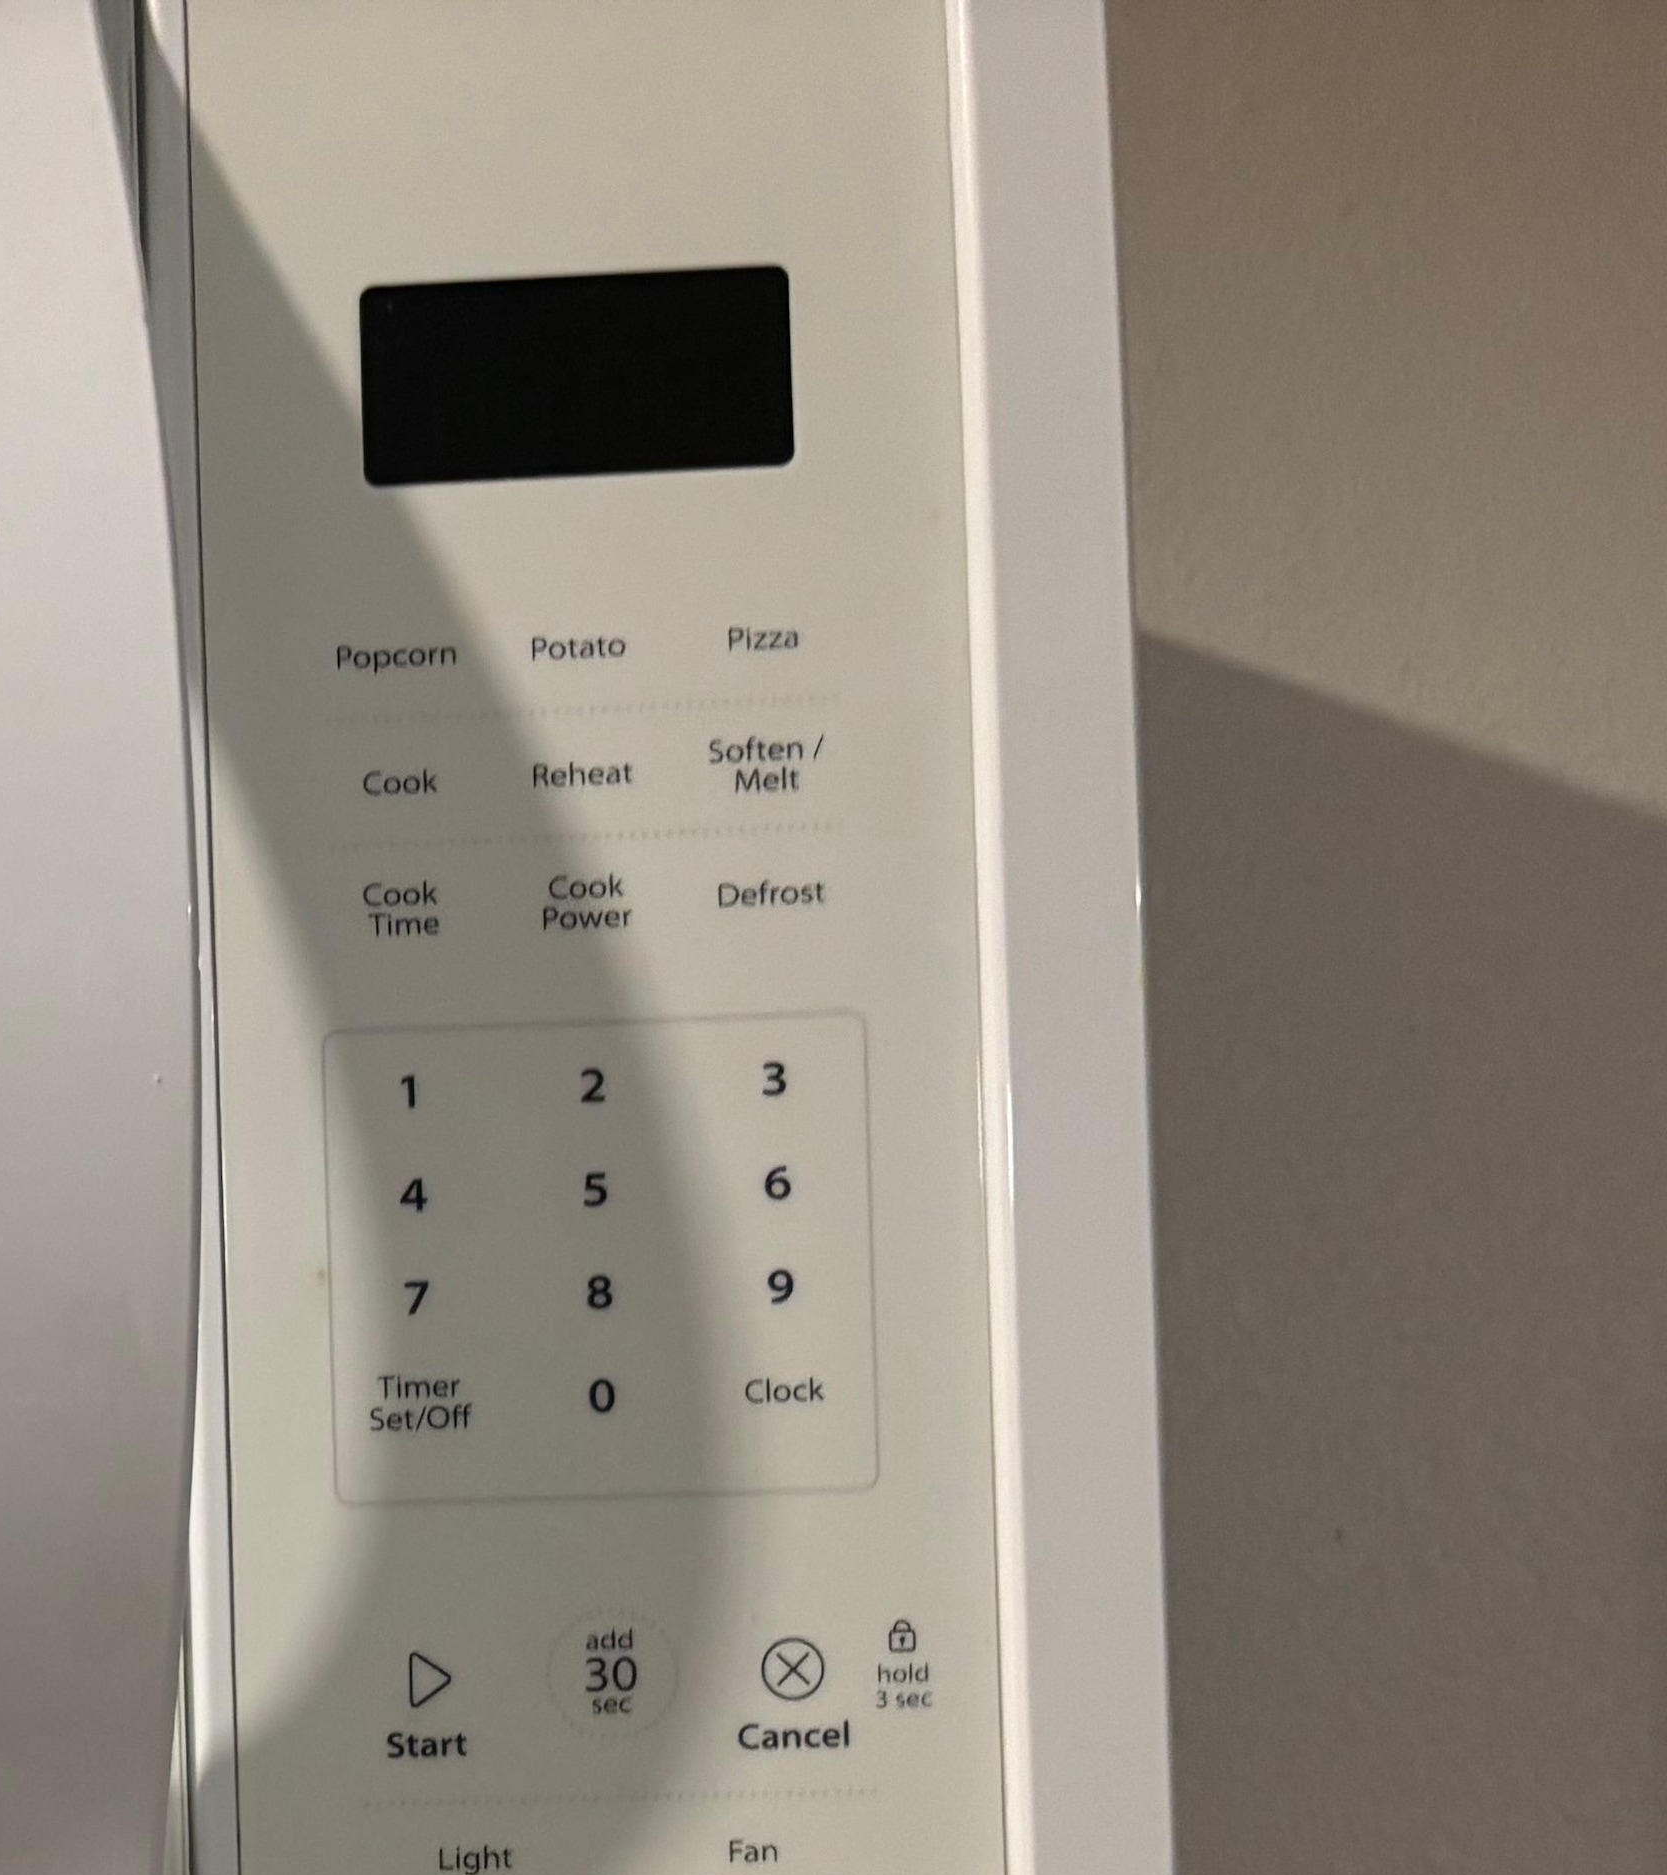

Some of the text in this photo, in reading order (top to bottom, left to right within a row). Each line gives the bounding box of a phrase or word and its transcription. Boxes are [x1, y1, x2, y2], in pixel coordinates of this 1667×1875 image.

[531, 636, 627, 662] Potato
[727, 626, 799, 652] Pizza
[336, 644, 458, 676] Popcorn
[708, 733, 825, 765] Soften /
[362, 768, 438, 797] Cook
[532, 760, 633, 789] Reheat
[734, 765, 800, 794] Melt
[362, 879, 438, 908] Cook
[548, 872, 624, 901] Cook
[717, 879, 825, 909] Defrost
[367, 911, 440, 938] Time
[542, 905, 632, 932] Power
[400, 1073, 416, 1110] 1
[580, 1066, 607, 1105] 2
[761, 1060, 788, 1098] 3
[399, 1176, 429, 1214] 4
[583, 1171, 609, 1209] 5
[763, 1164, 792, 1202] 6
[403, 1279, 430, 1317] 7
[586, 1273, 614, 1312] 8
[766, 1268, 795, 1306] 9
[377, 1374, 461, 1401] Timer
[588, 1377, 616, 1415] 0
[744, 1376, 825, 1405] Clock
[369, 1402, 473, 1433] Set/Off
[585, 1627, 634, 1652] add
[585, 1655, 638, 1694] 30
[877, 1661, 930, 1685] hold
[591, 1696, 632, 1716] sec
[876, 1689, 933, 1710] 3 sec
[386, 1731, 468, 1760] Start
[737, 1718, 850, 1751] Cancel
[728, 1838, 778, 1864] Fan
